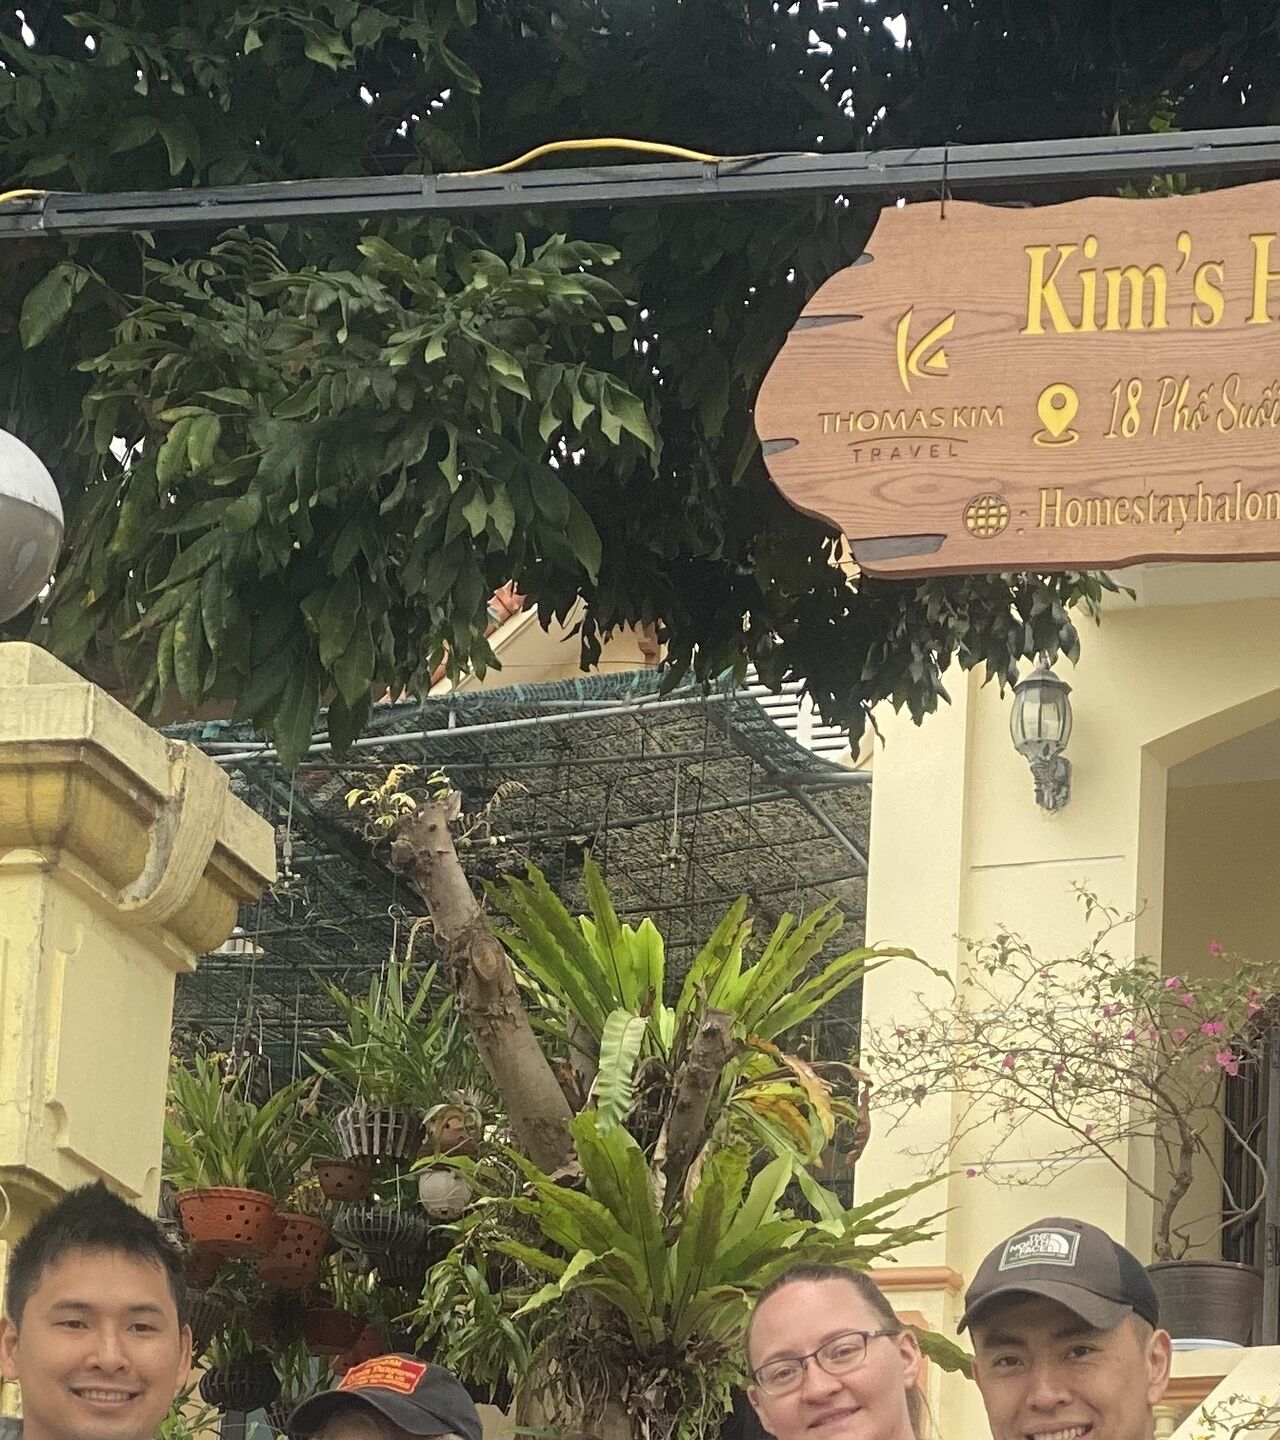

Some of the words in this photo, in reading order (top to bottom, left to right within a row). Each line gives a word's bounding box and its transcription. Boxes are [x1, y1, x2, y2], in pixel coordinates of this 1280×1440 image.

[1021, 231, 1225, 335] Kim's
[818, 407, 945, 434] THOMAS
[951, 405, 1004, 428] KIM
[1103, 377, 1143, 439] 18
[1151, 374, 1215, 436] Phố
[852, 443, 958, 463] TRAVEL
